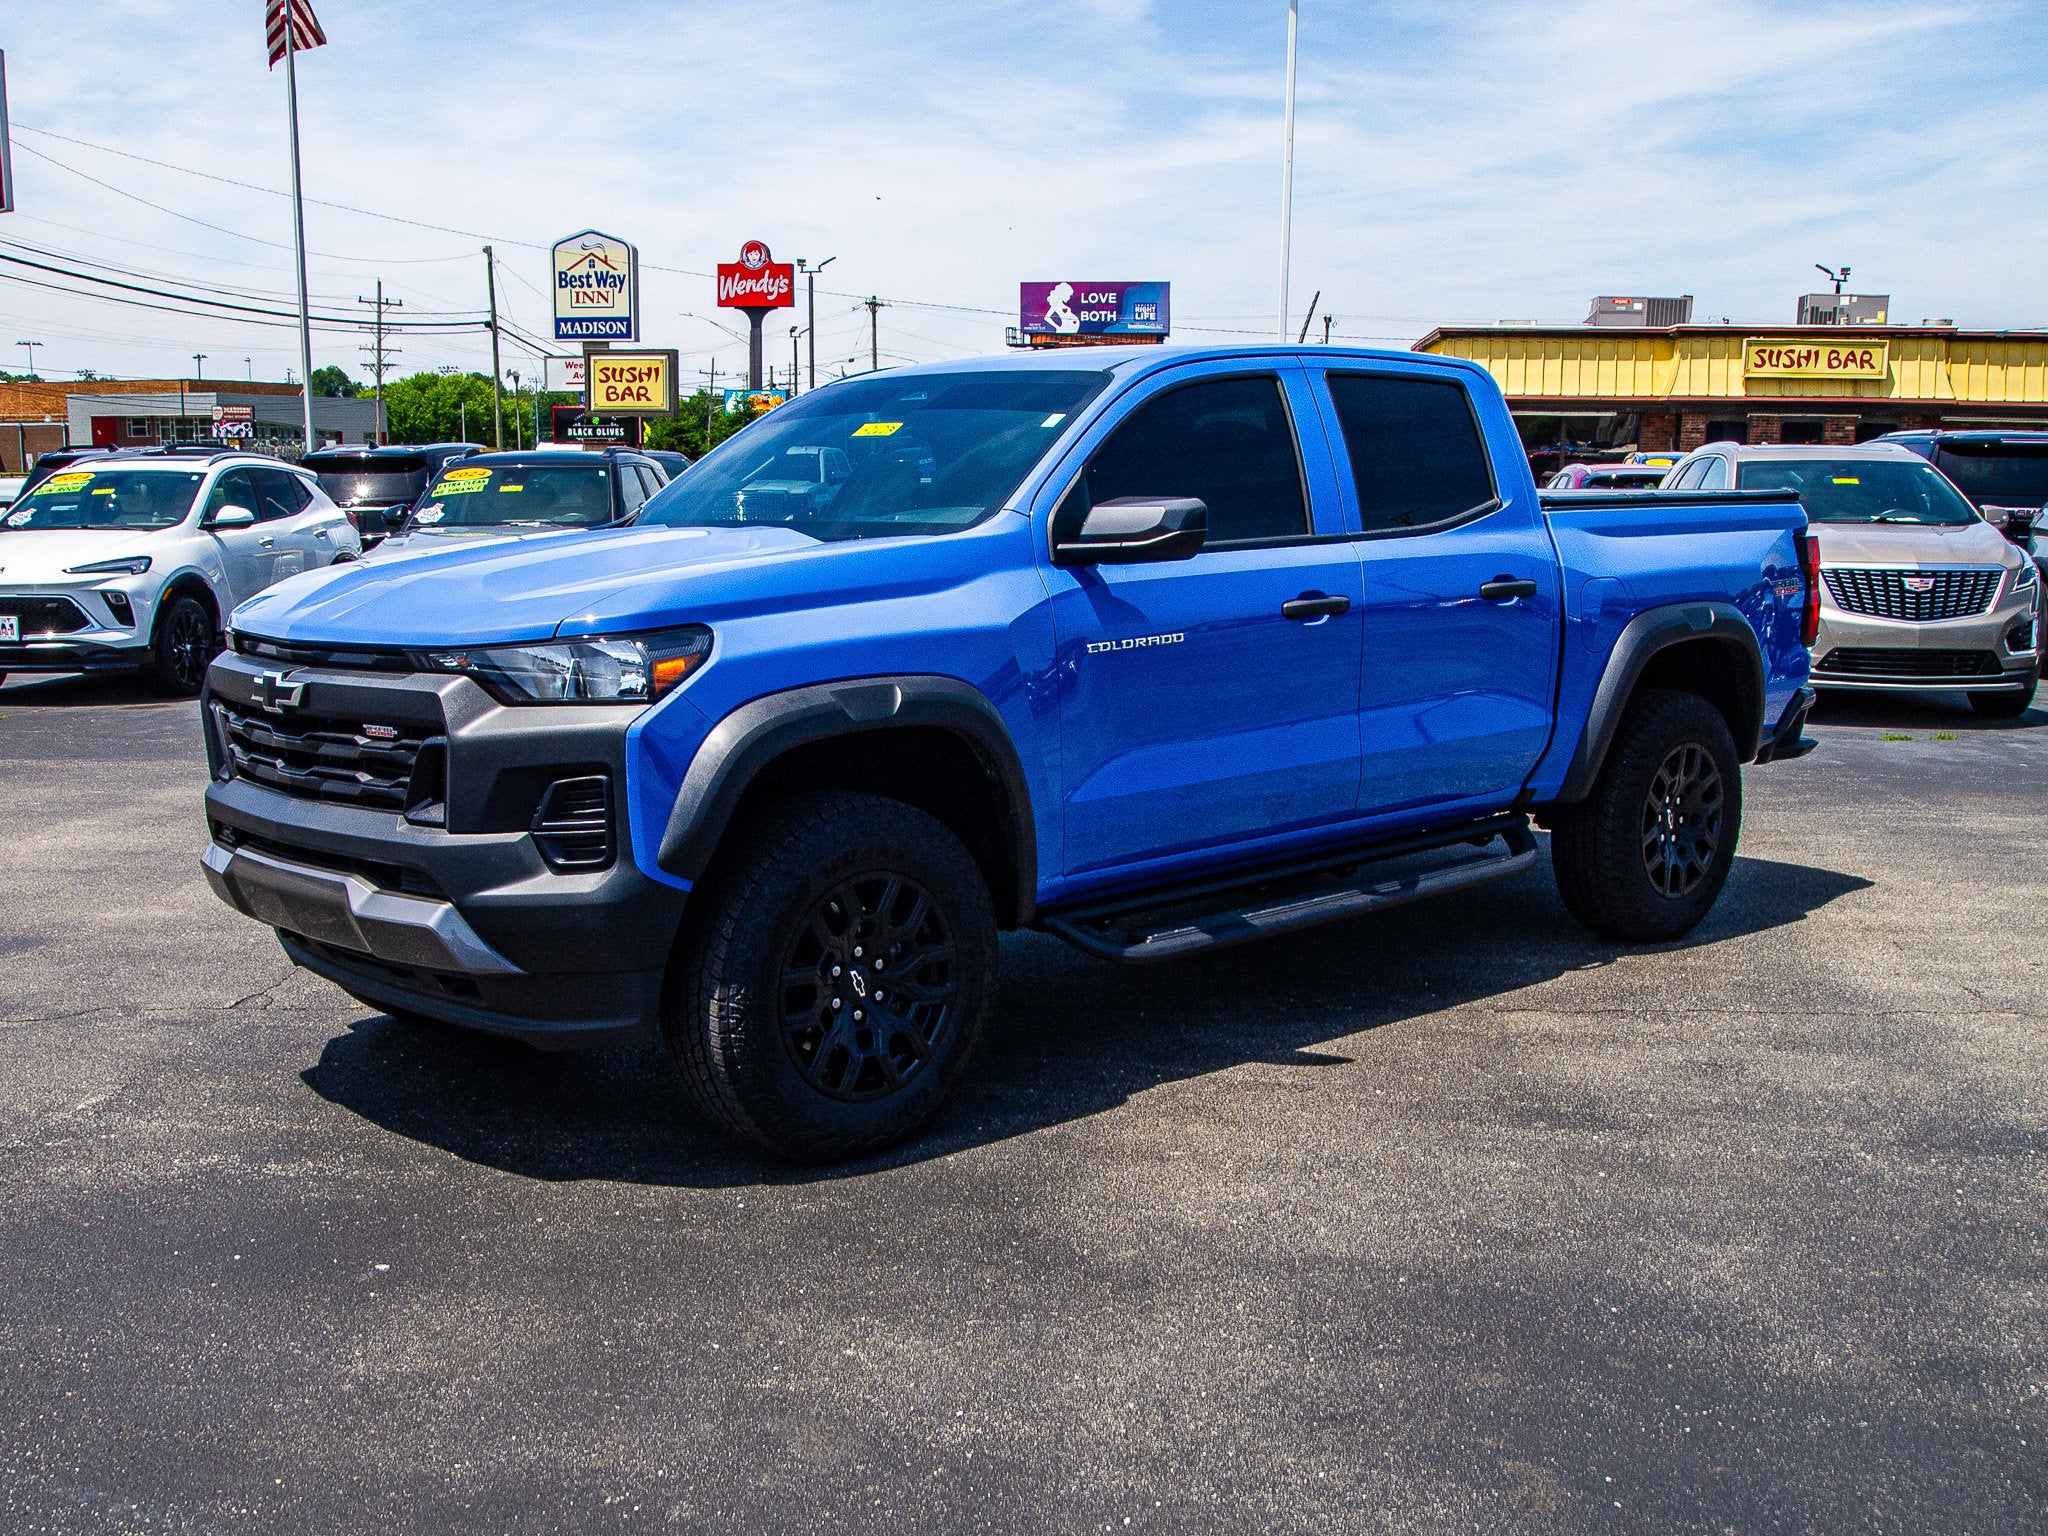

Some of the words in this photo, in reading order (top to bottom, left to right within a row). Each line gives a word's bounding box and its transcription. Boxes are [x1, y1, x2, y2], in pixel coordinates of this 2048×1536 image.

[558, 270, 592, 289] Best
[592, 271, 627, 294] Way
[719, 270, 790, 301] Wendy's
[574, 290, 611, 305] INN
[1080, 292, 1117, 304] LOVE
[1080, 310, 1117, 322] BOTH
[1134, 312, 1157, 320] LIFE
[559, 321, 628, 336] MADISON
[1753, 348, 1820, 369] SUSHI
[1827, 349, 1876, 370] BAR
[598, 366, 660, 384] SUSHI
[605, 385, 653, 402] BAR
[567, 427, 594, 437] BLACK
[595, 427, 625, 437] OLIVES
[1772, 578, 1802, 588] TRAIL
[1086, 632, 1185, 654] COLORADO
